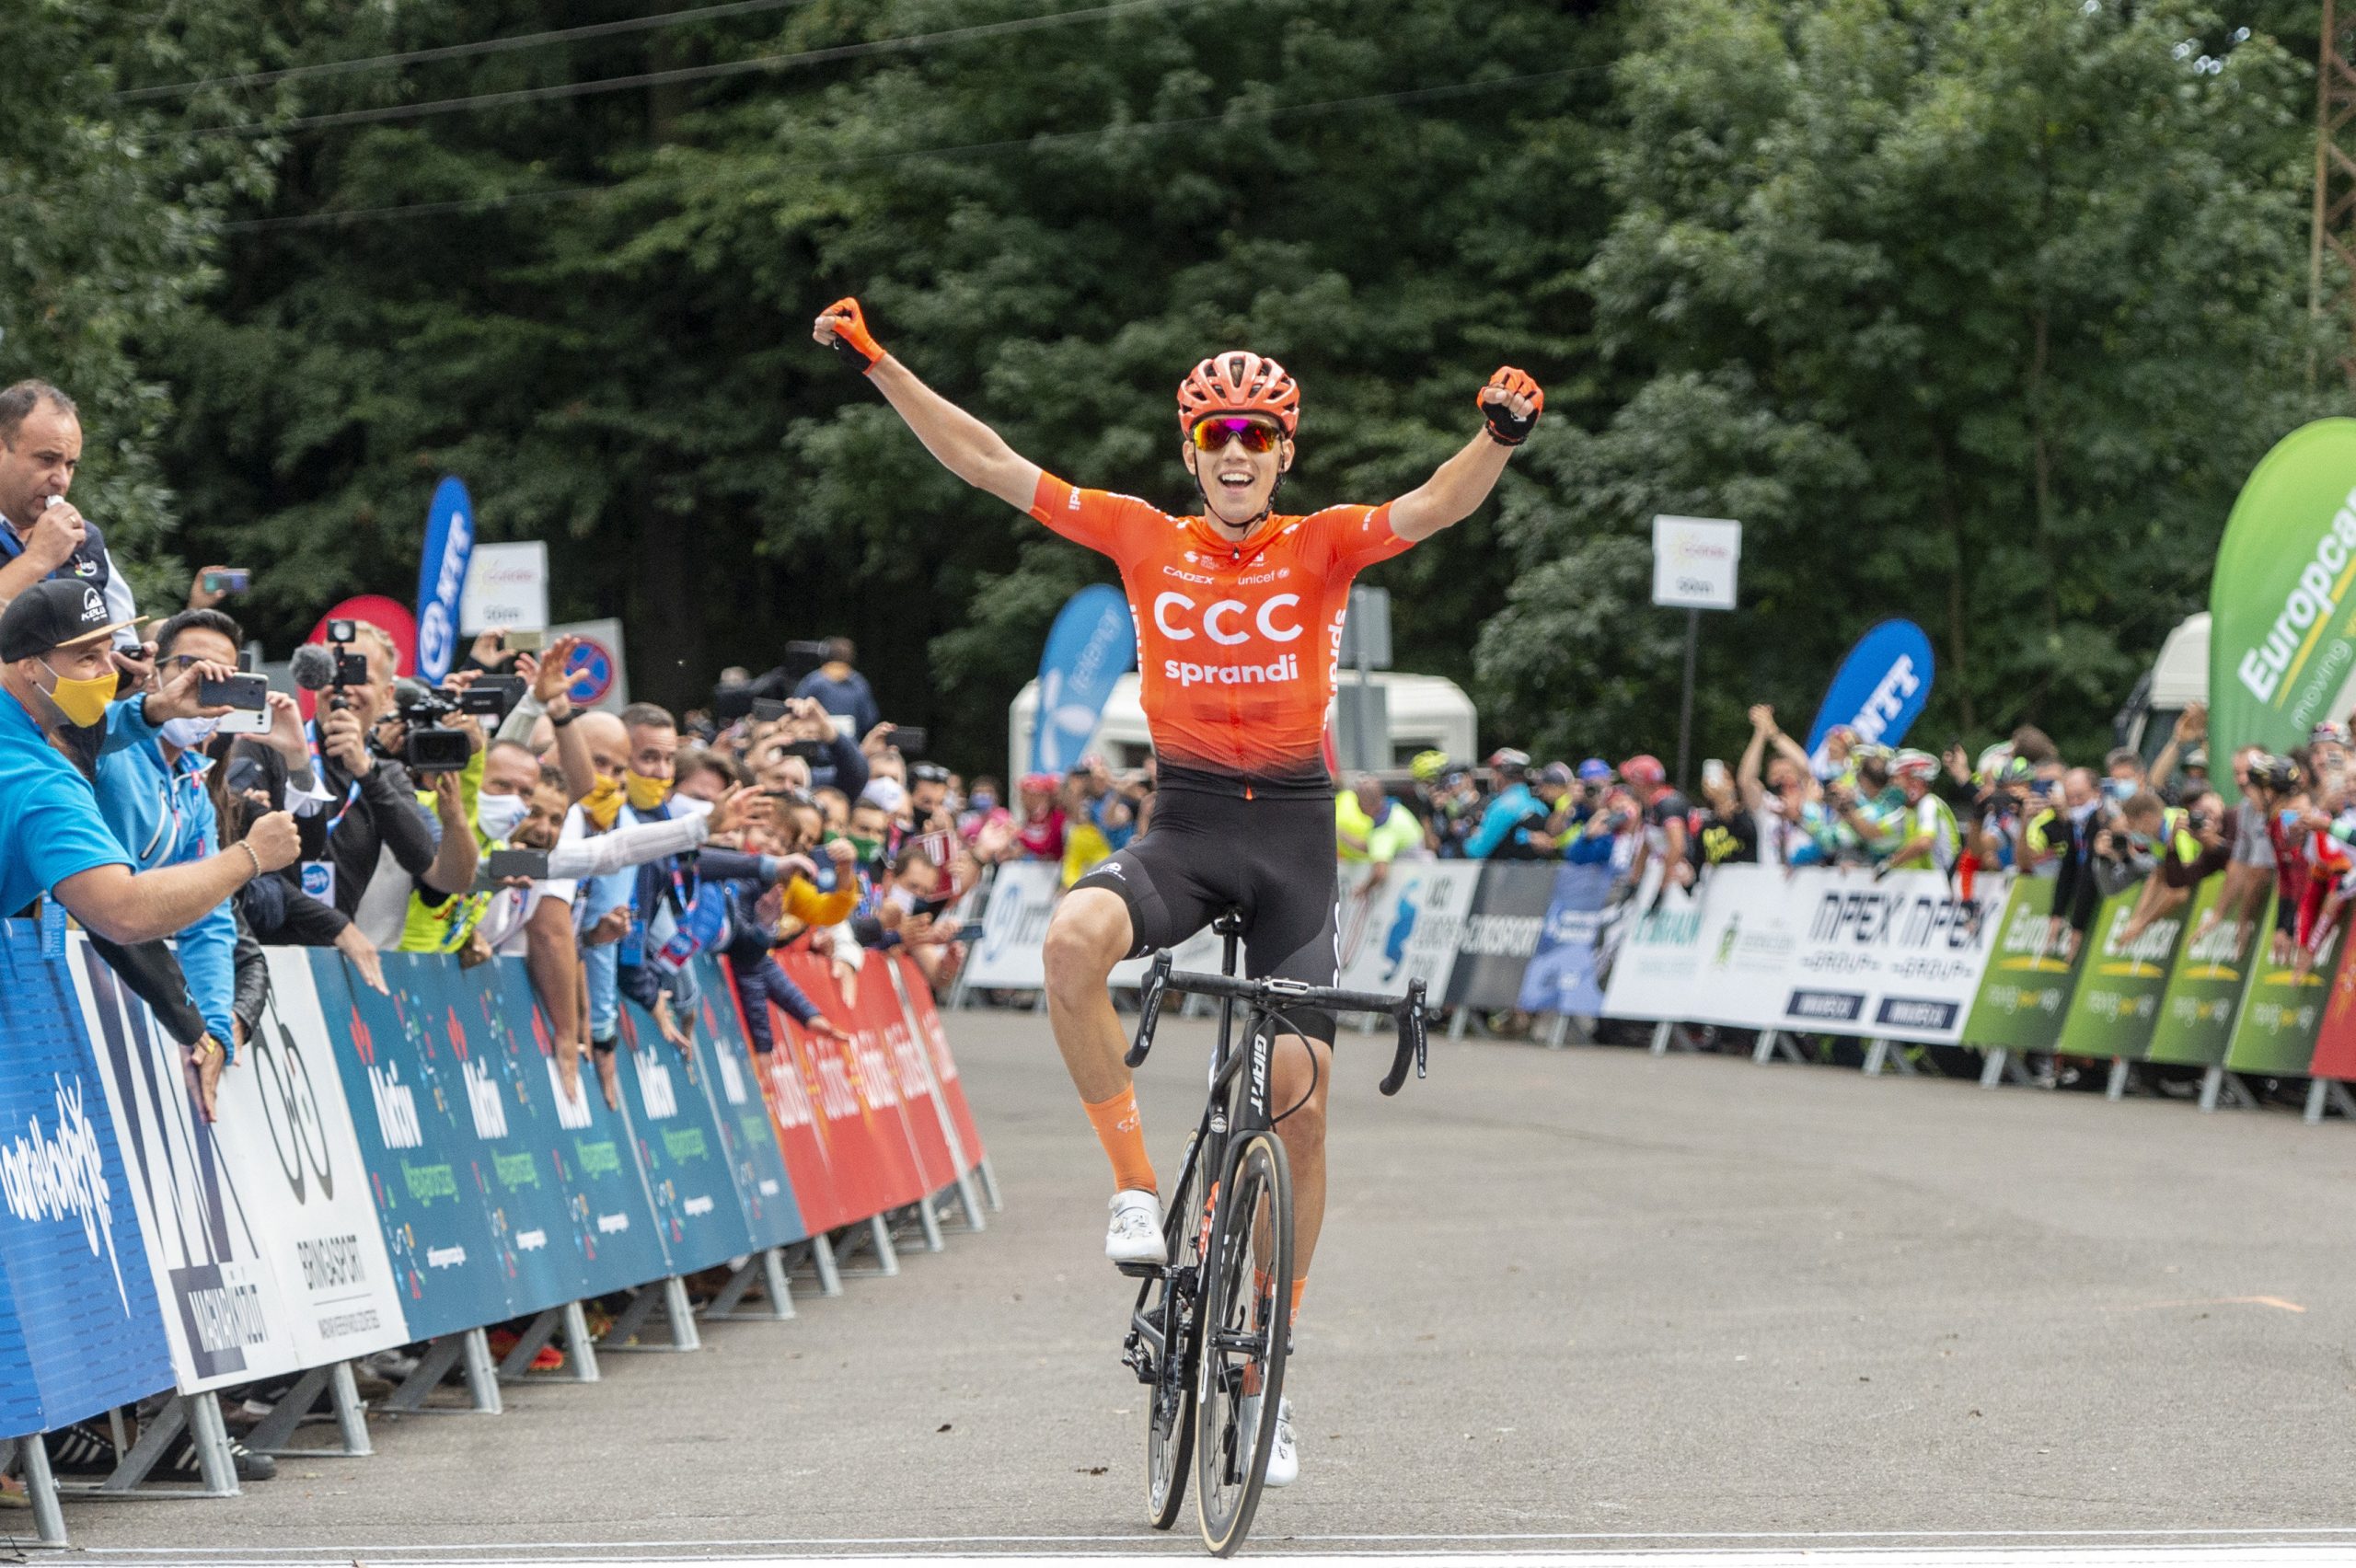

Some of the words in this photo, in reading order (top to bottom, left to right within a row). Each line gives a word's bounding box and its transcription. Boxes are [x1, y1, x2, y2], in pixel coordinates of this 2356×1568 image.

[1162, 565, 1215, 585] CADEX
[1238, 571, 1276, 586] unicef
[1154, 591, 1303, 646] CCC
[1164, 653, 1299, 687] sprandi
[2290, 638, 2353, 732] moving
[1251, 1033, 1267, 1117] GIANT
